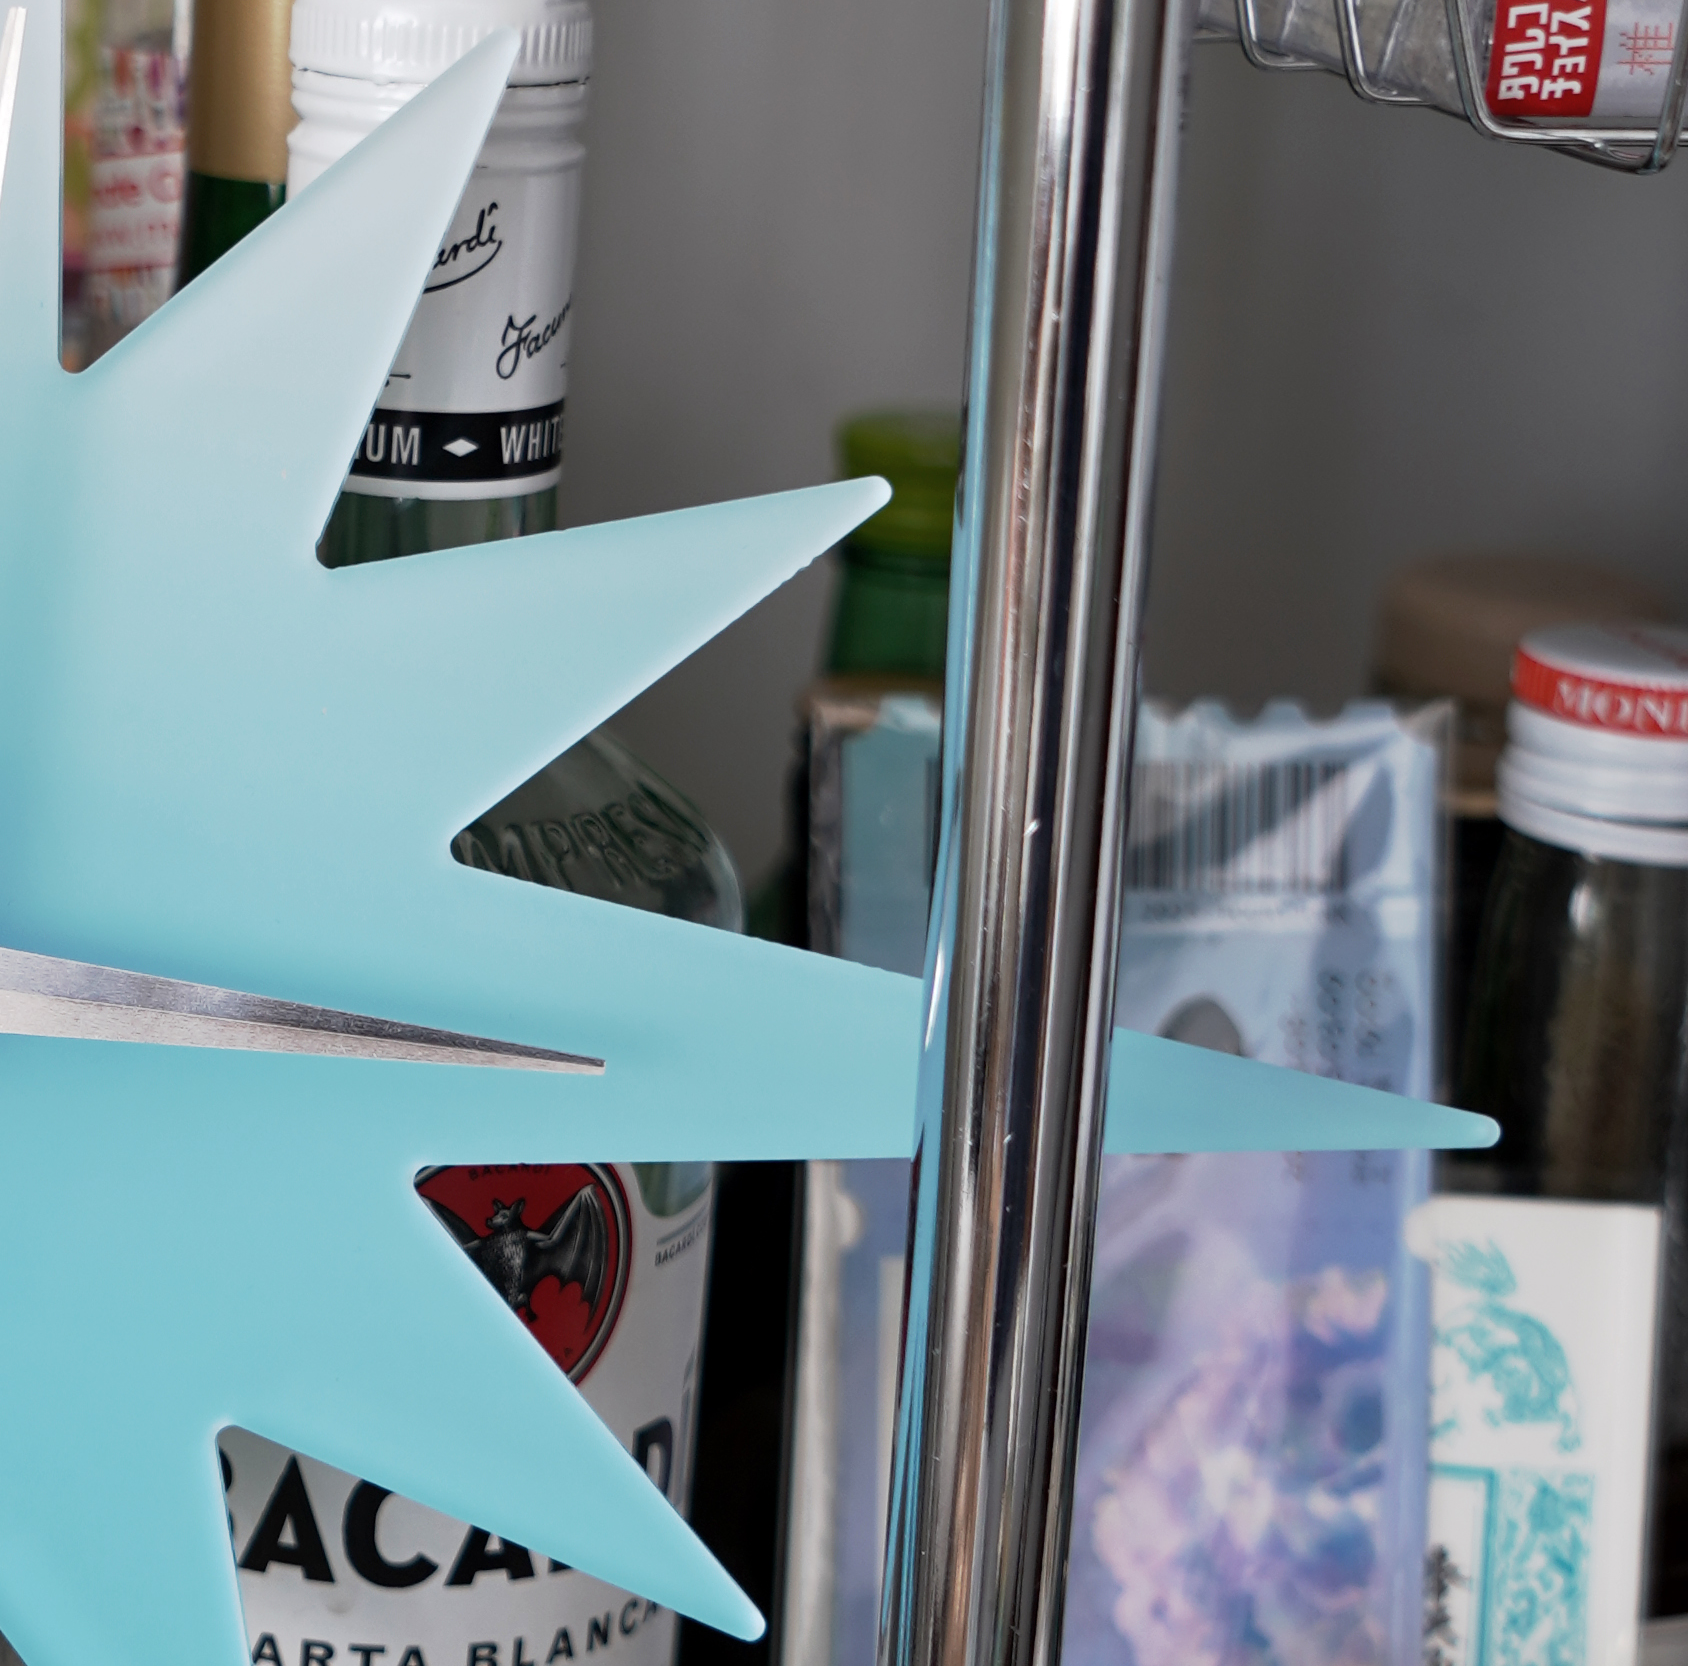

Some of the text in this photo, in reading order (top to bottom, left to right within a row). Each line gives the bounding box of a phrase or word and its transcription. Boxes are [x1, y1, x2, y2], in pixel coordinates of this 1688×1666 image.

[1497, 2, 1550, 101] タワレコ
[1540, 5, 1593, 101] チョイス
[500, 415, 563, 465] WHIT
